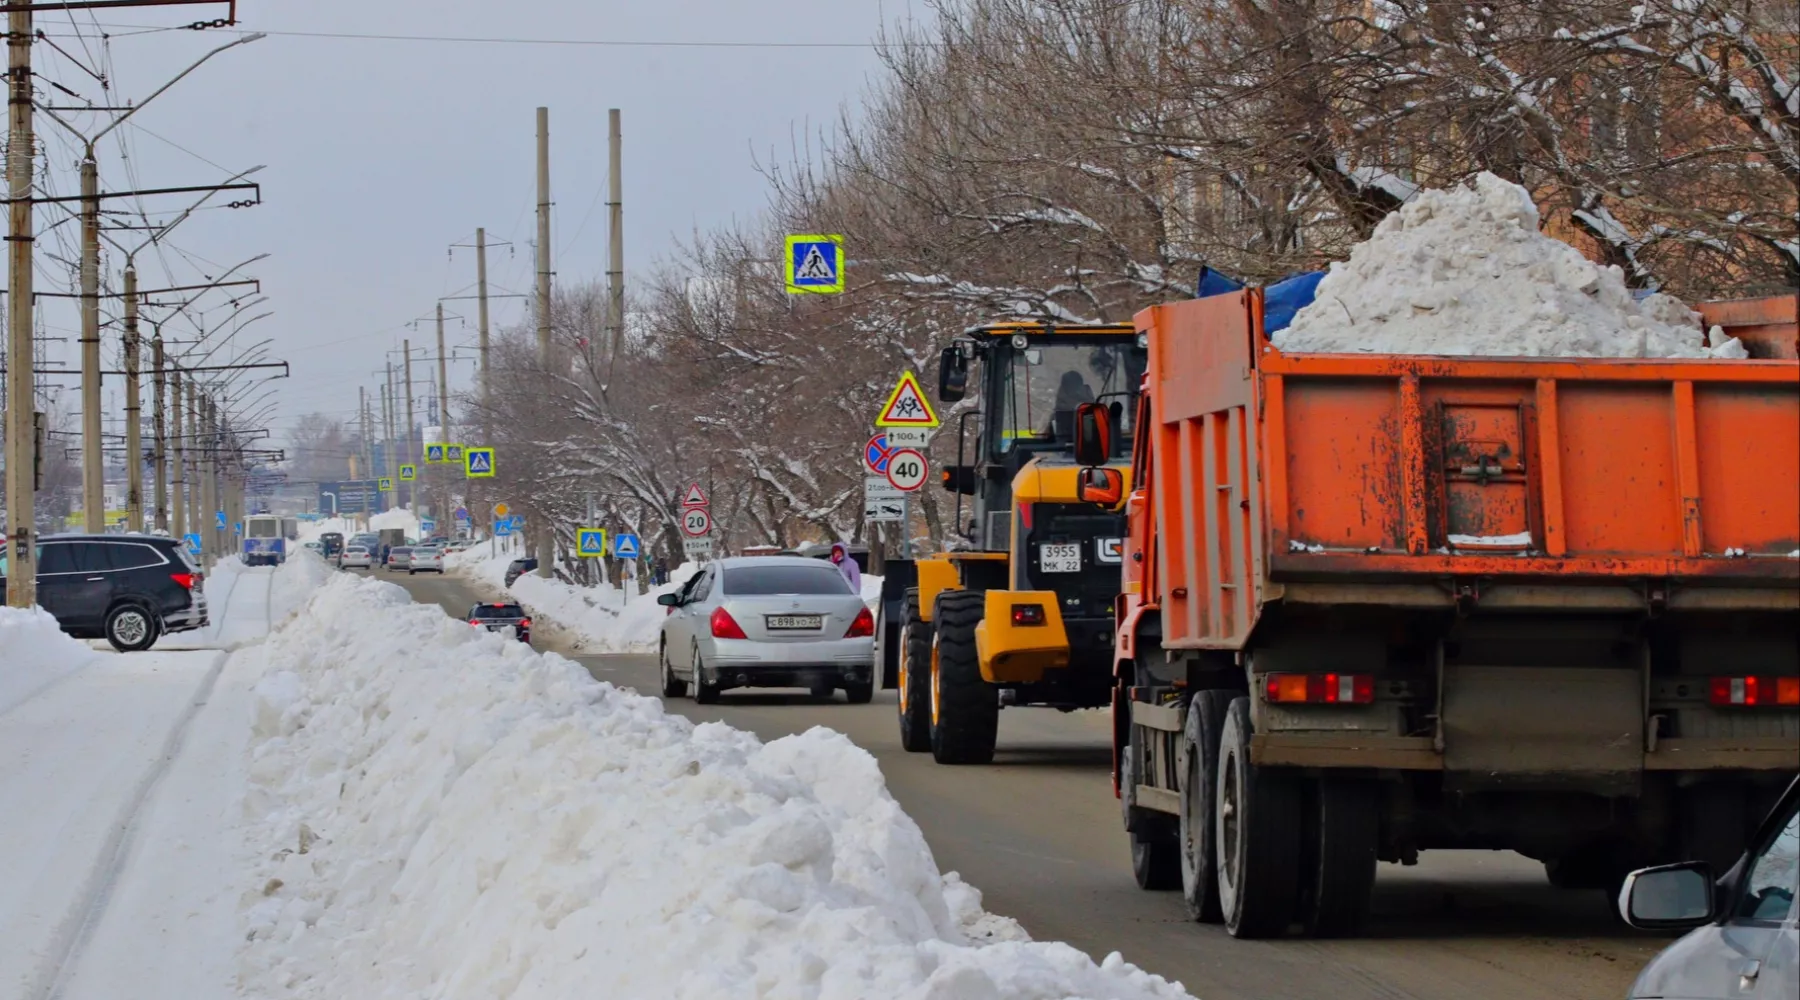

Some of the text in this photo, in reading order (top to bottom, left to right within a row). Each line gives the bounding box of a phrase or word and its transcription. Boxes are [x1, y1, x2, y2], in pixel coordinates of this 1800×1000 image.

[895, 462, 919, 478] 40
[688, 516, 705, 528] 20
[1045, 546, 1076, 558] 3955
[1066, 561, 1078, 570] 22
